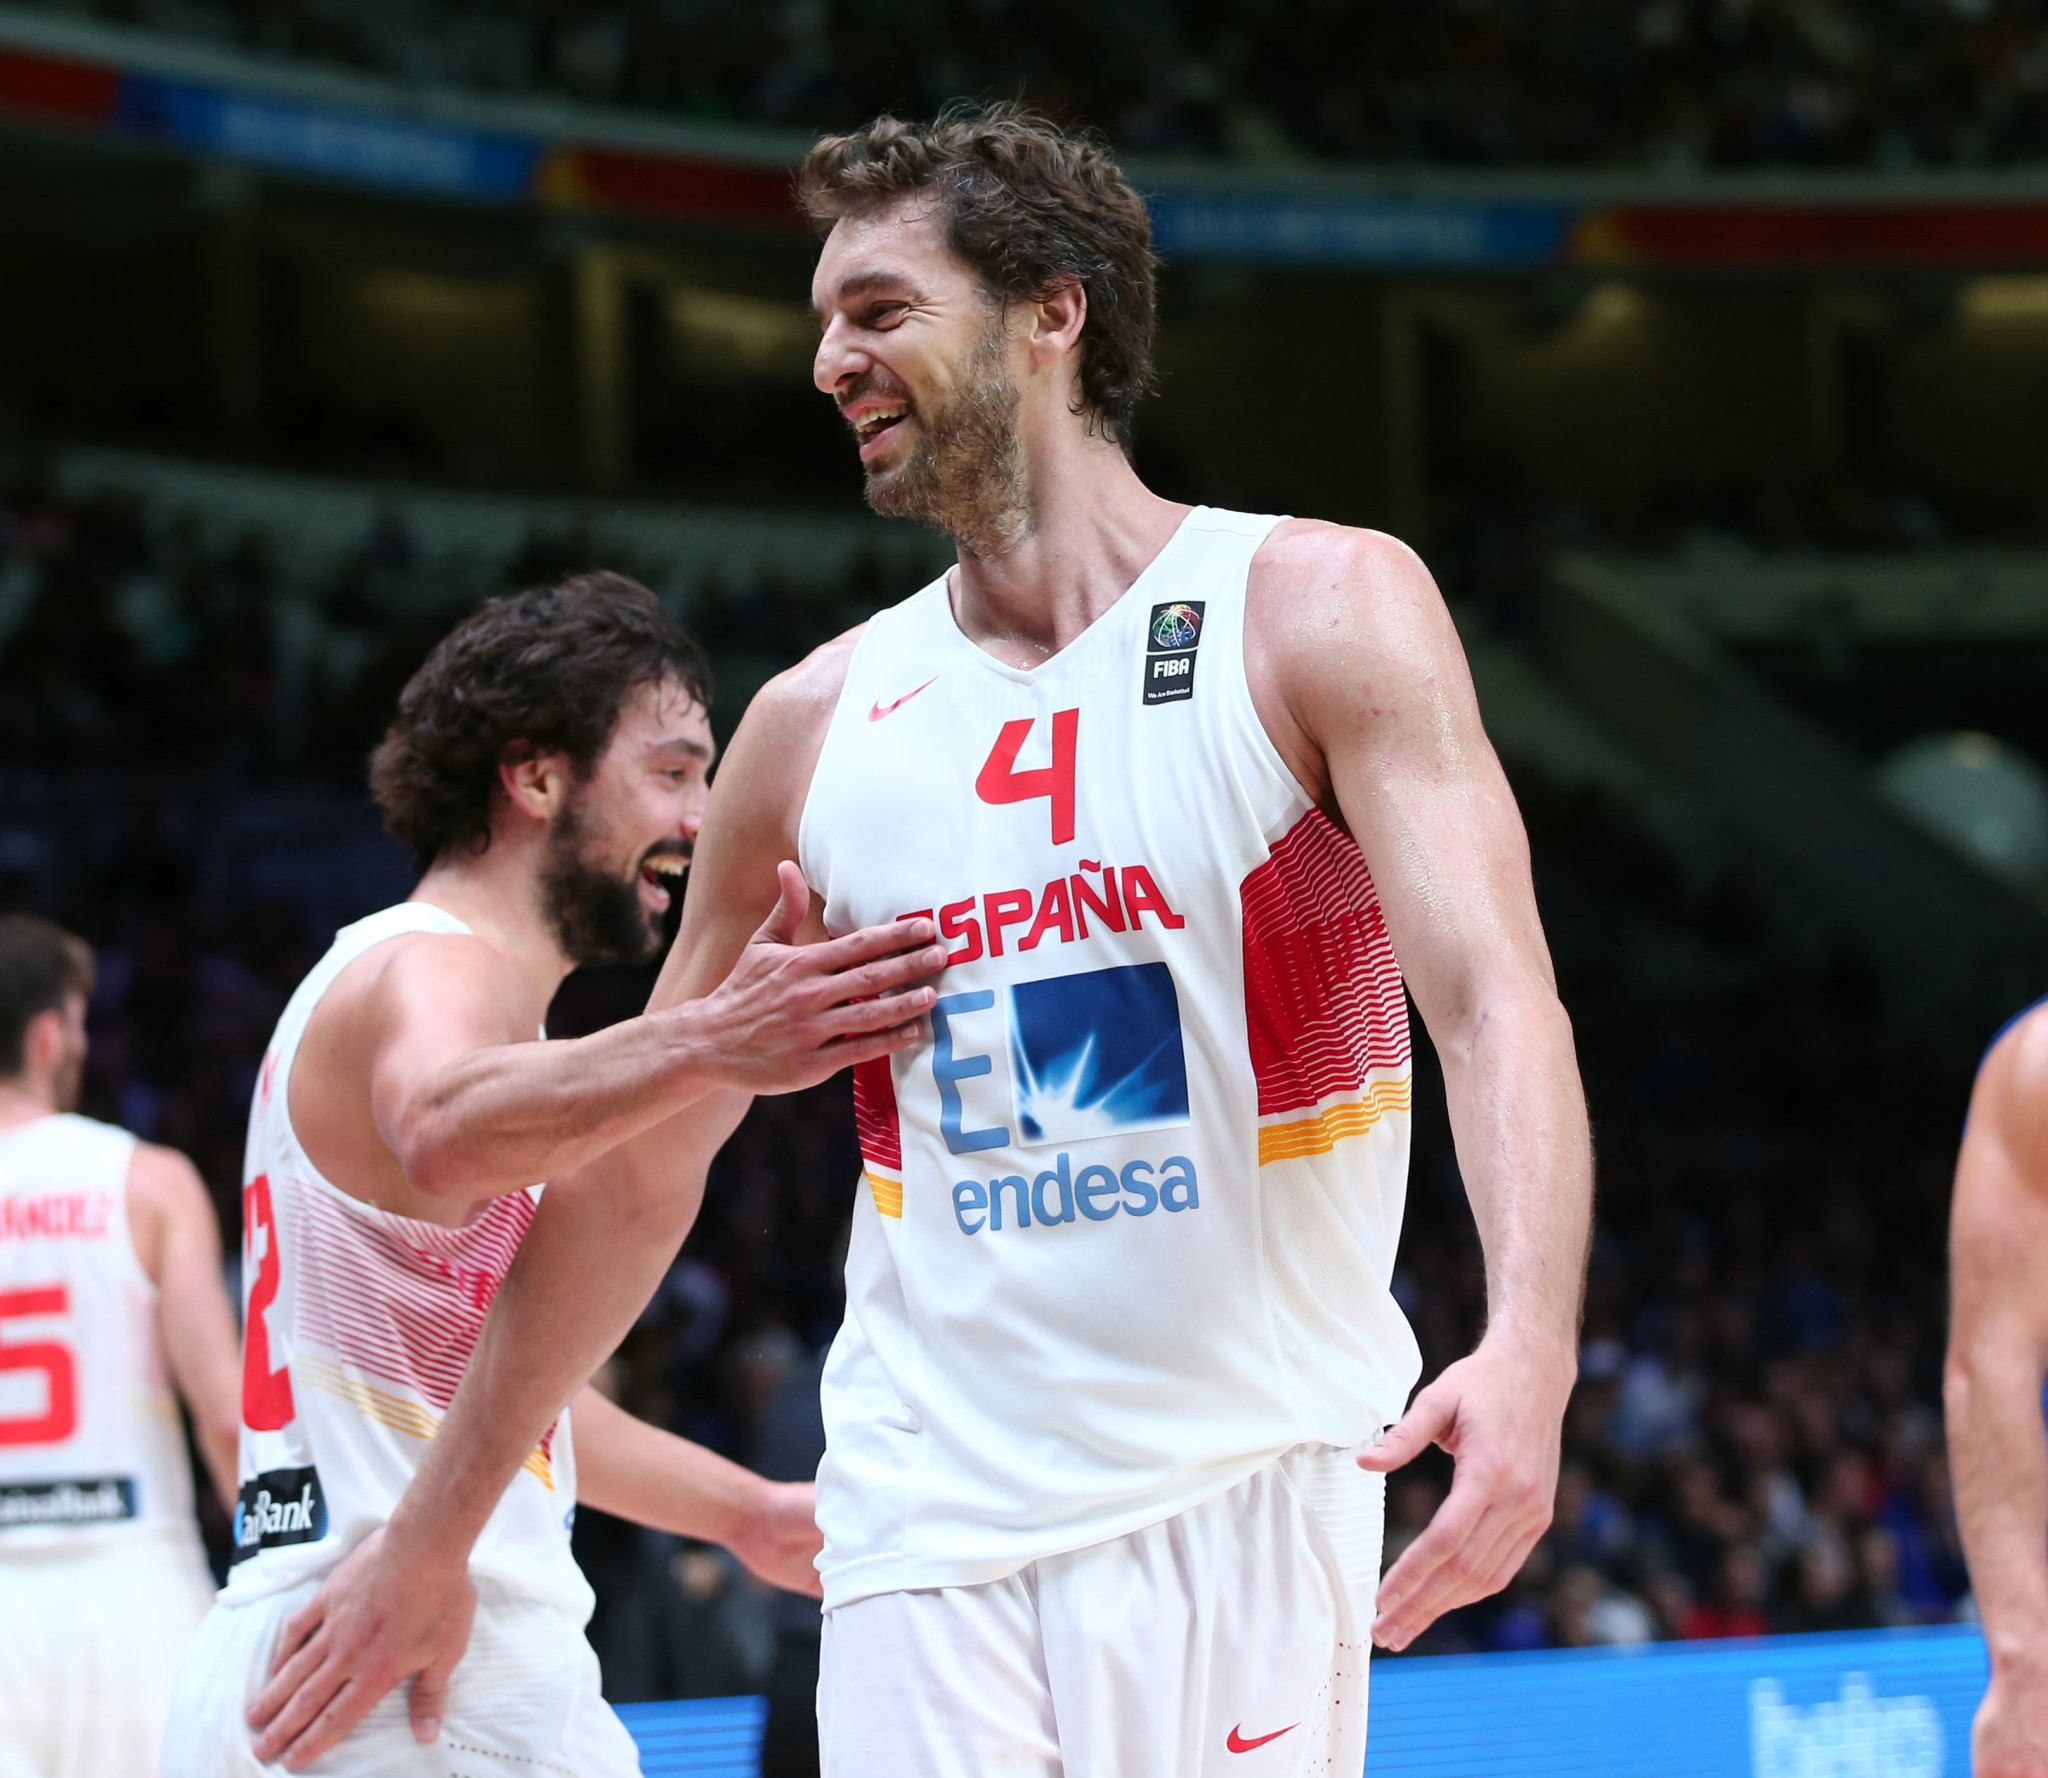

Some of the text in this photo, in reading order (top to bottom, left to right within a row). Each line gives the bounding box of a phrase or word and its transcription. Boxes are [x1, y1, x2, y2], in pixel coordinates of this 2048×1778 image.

[1153, 658, 1190, 679] FIBA
[976, 708, 1079, 845] 4
[952, 1152, 1199, 1235] endesa
